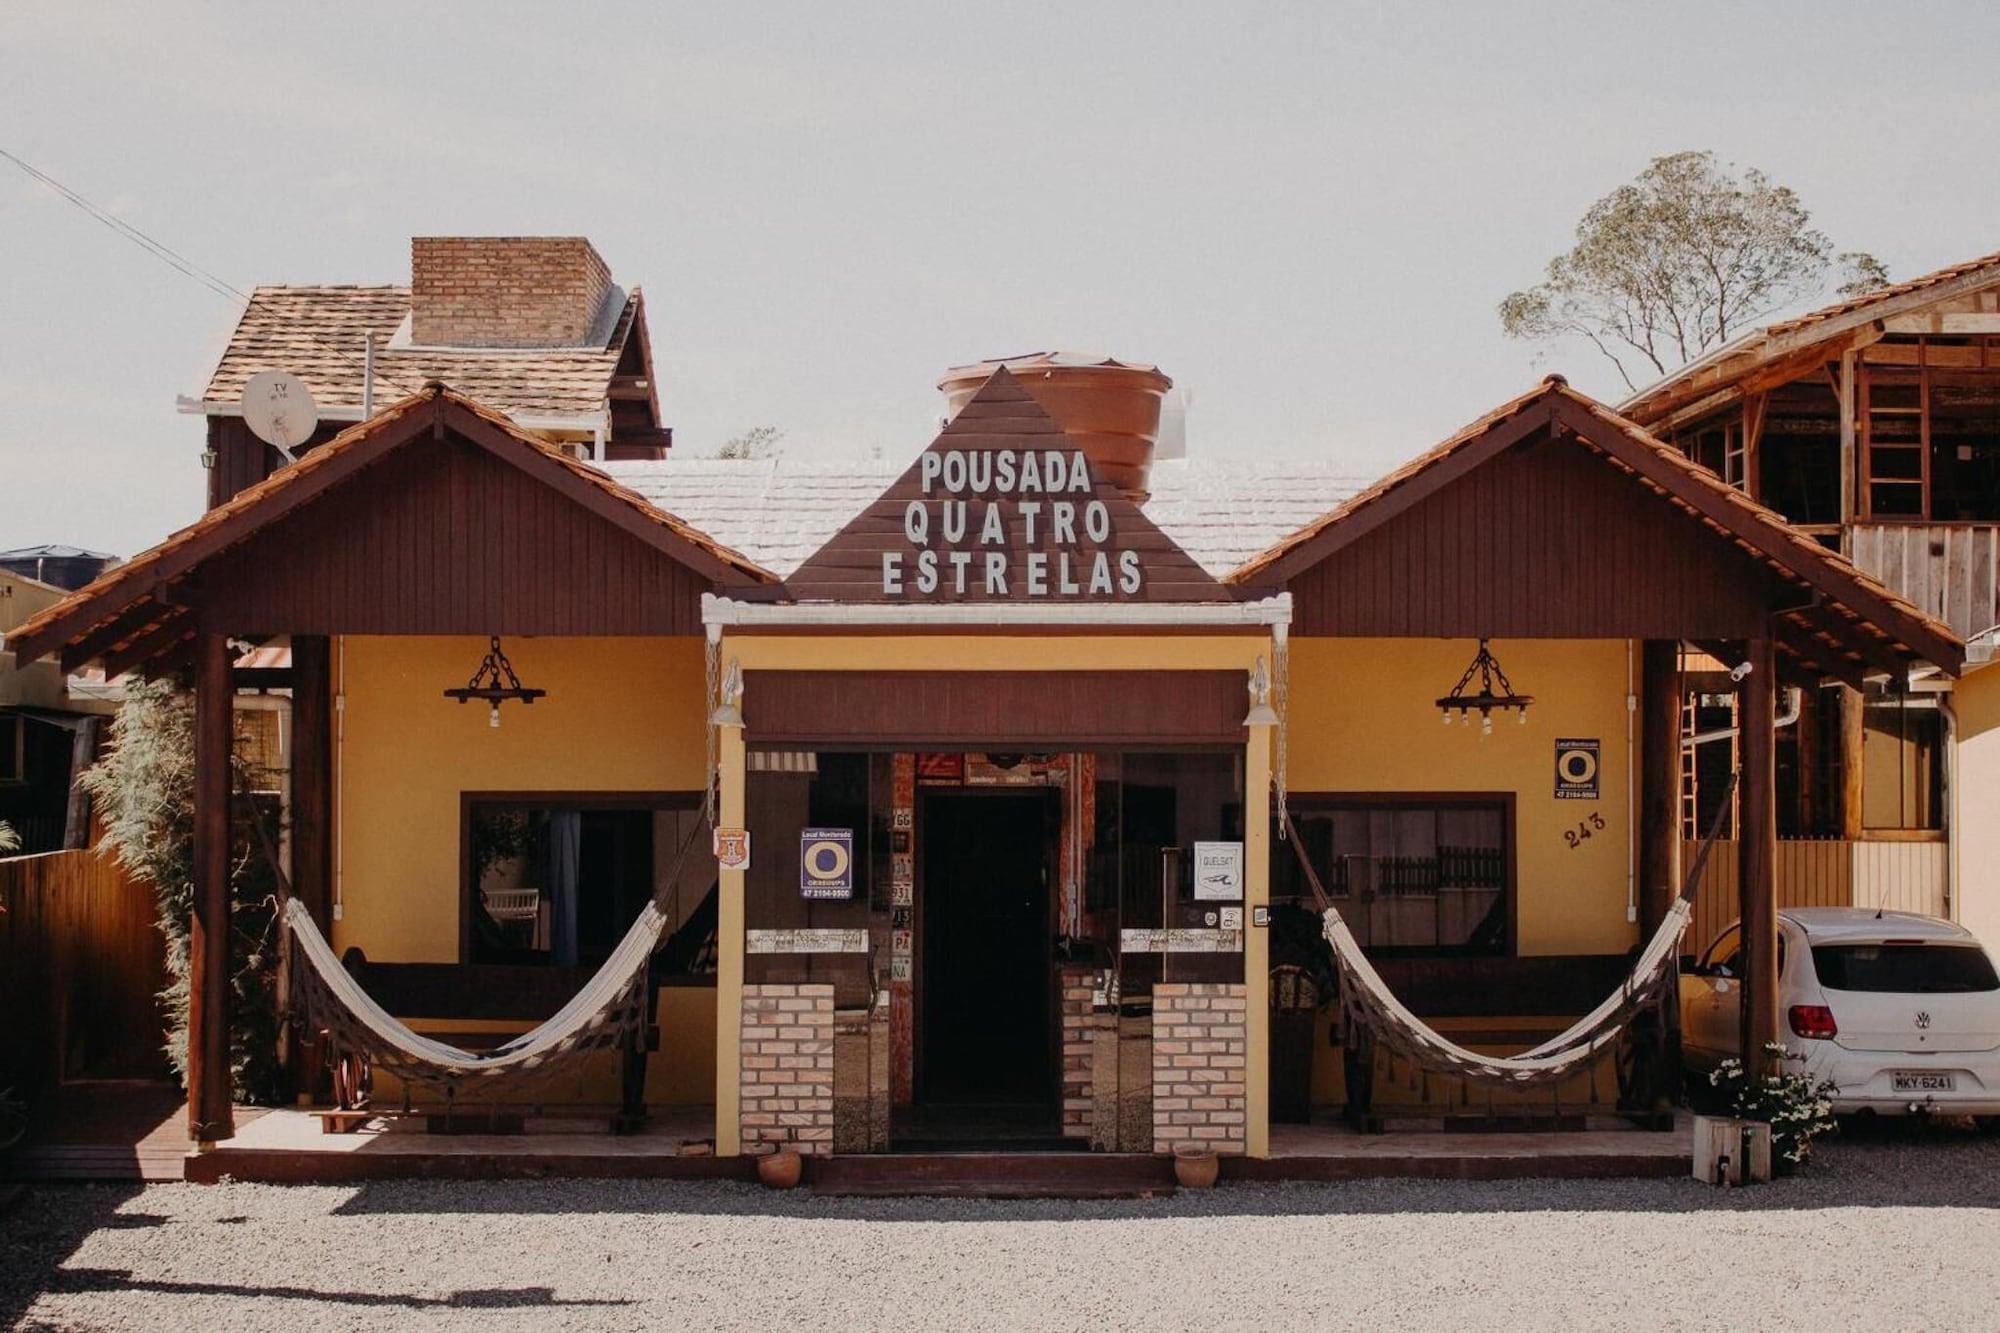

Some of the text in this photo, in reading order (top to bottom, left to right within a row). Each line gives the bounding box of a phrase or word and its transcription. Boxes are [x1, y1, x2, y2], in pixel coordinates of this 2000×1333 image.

[921, 450, 1091, 493] POUSADA
[904, 501, 1110, 546] QUATRO
[882, 550, 1141, 595] ESTRELAS
[1564, 811, 1606, 849] 243
